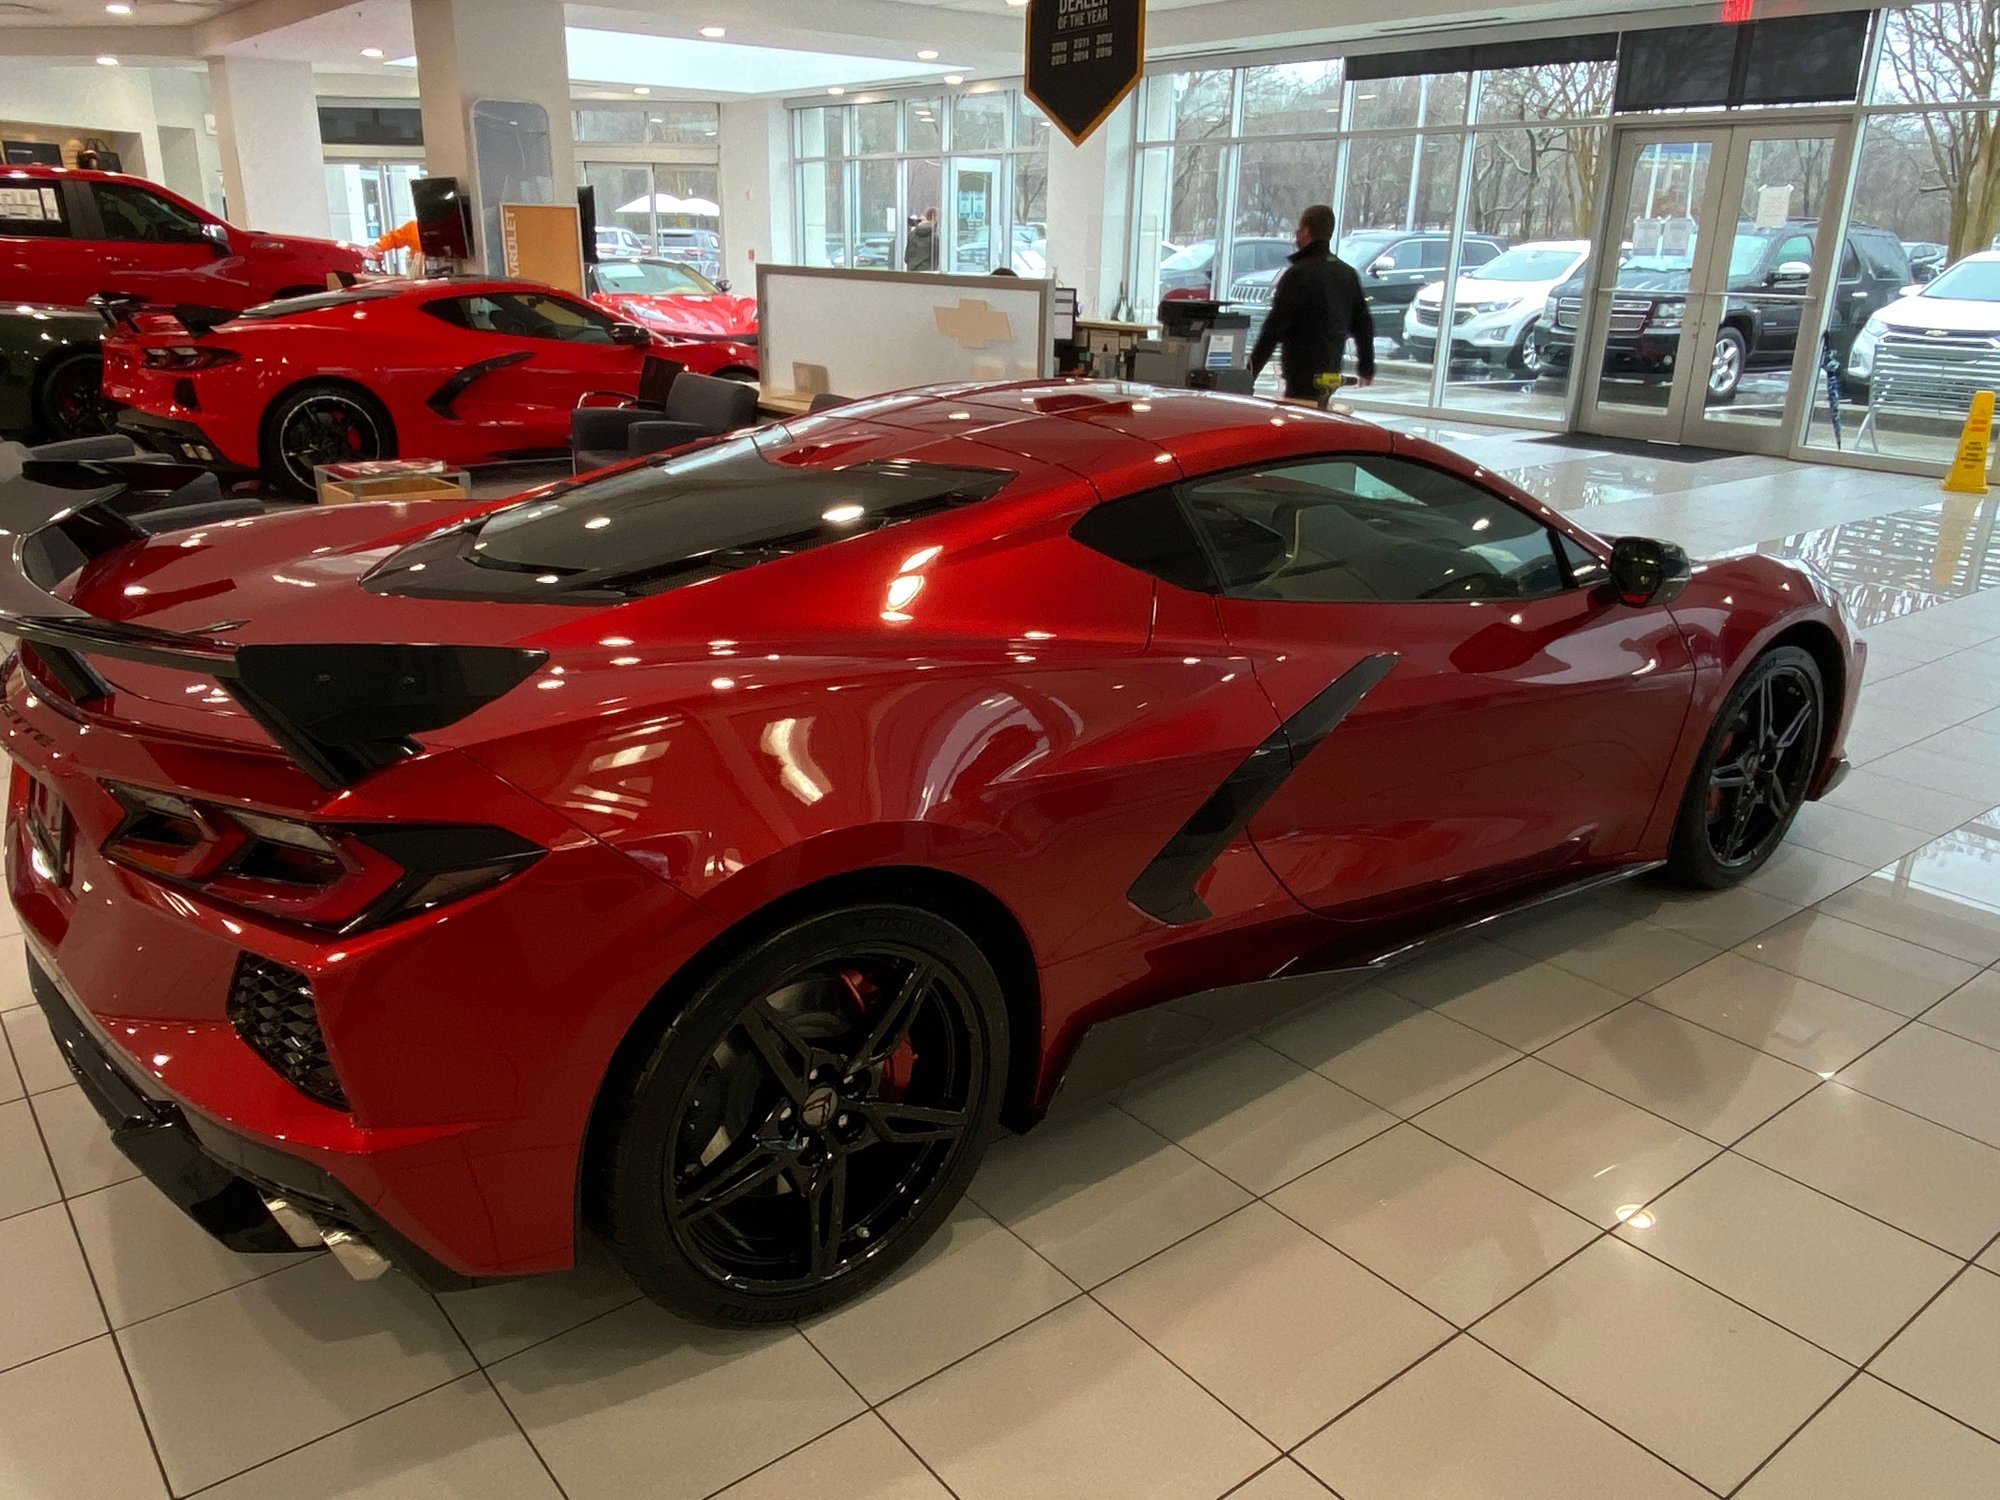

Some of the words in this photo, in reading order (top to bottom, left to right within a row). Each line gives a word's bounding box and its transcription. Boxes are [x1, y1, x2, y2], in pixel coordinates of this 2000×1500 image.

[1057, 15, 1068, 30] OF
[1070, 12, 1085, 28] THE
[1087, 8, 1108, 24] YEAR
